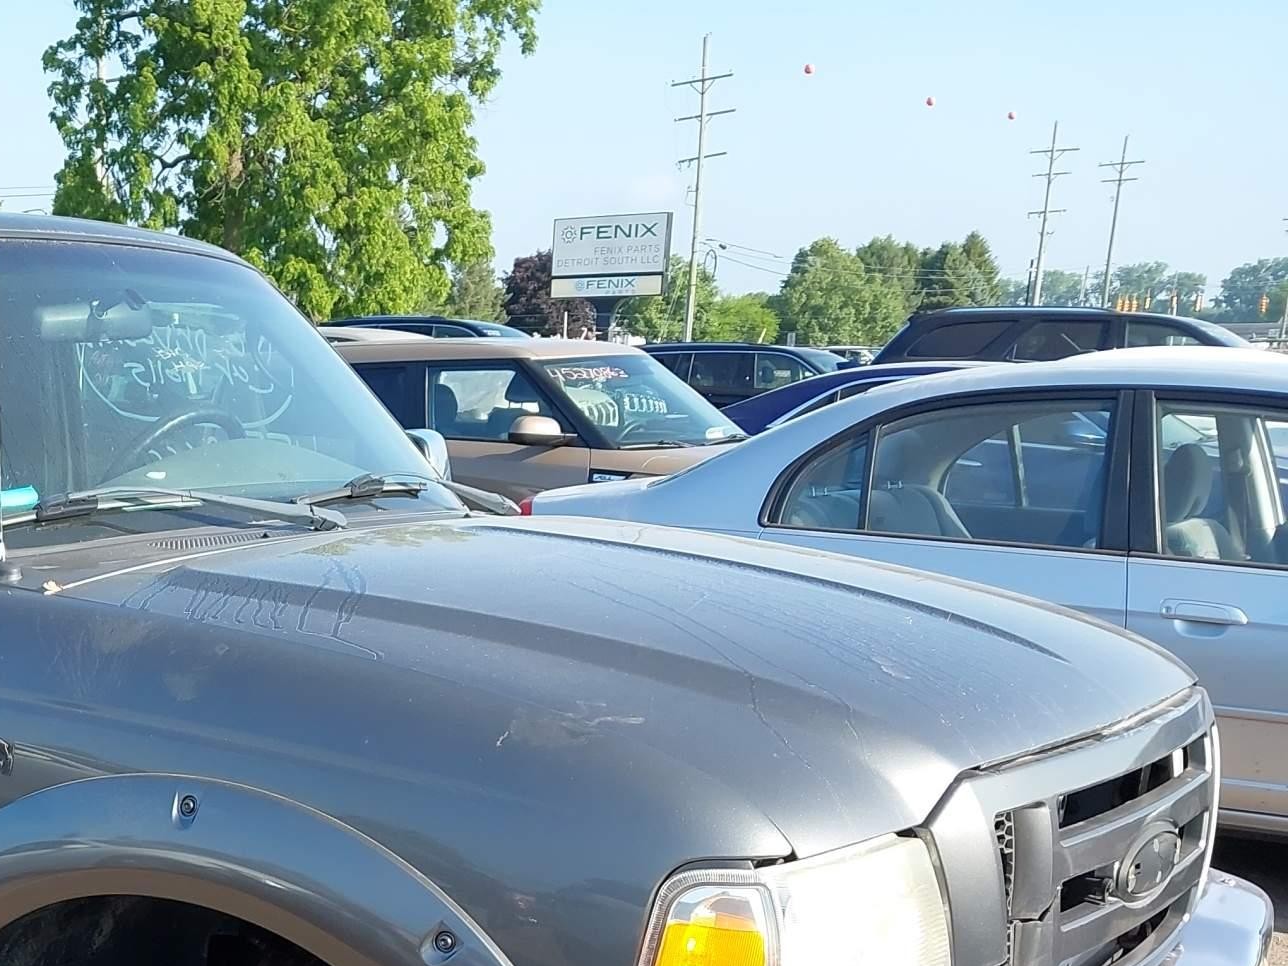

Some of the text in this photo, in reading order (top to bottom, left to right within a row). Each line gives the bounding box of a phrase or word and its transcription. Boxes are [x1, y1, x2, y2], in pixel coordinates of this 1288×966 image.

[579, 222, 658, 240] FENIX
[593, 244, 661, 256] FENIX PARTS
[556, 254, 660, 268] DETROIT SOUTH LLC
[585, 278, 636, 290] FENIX
